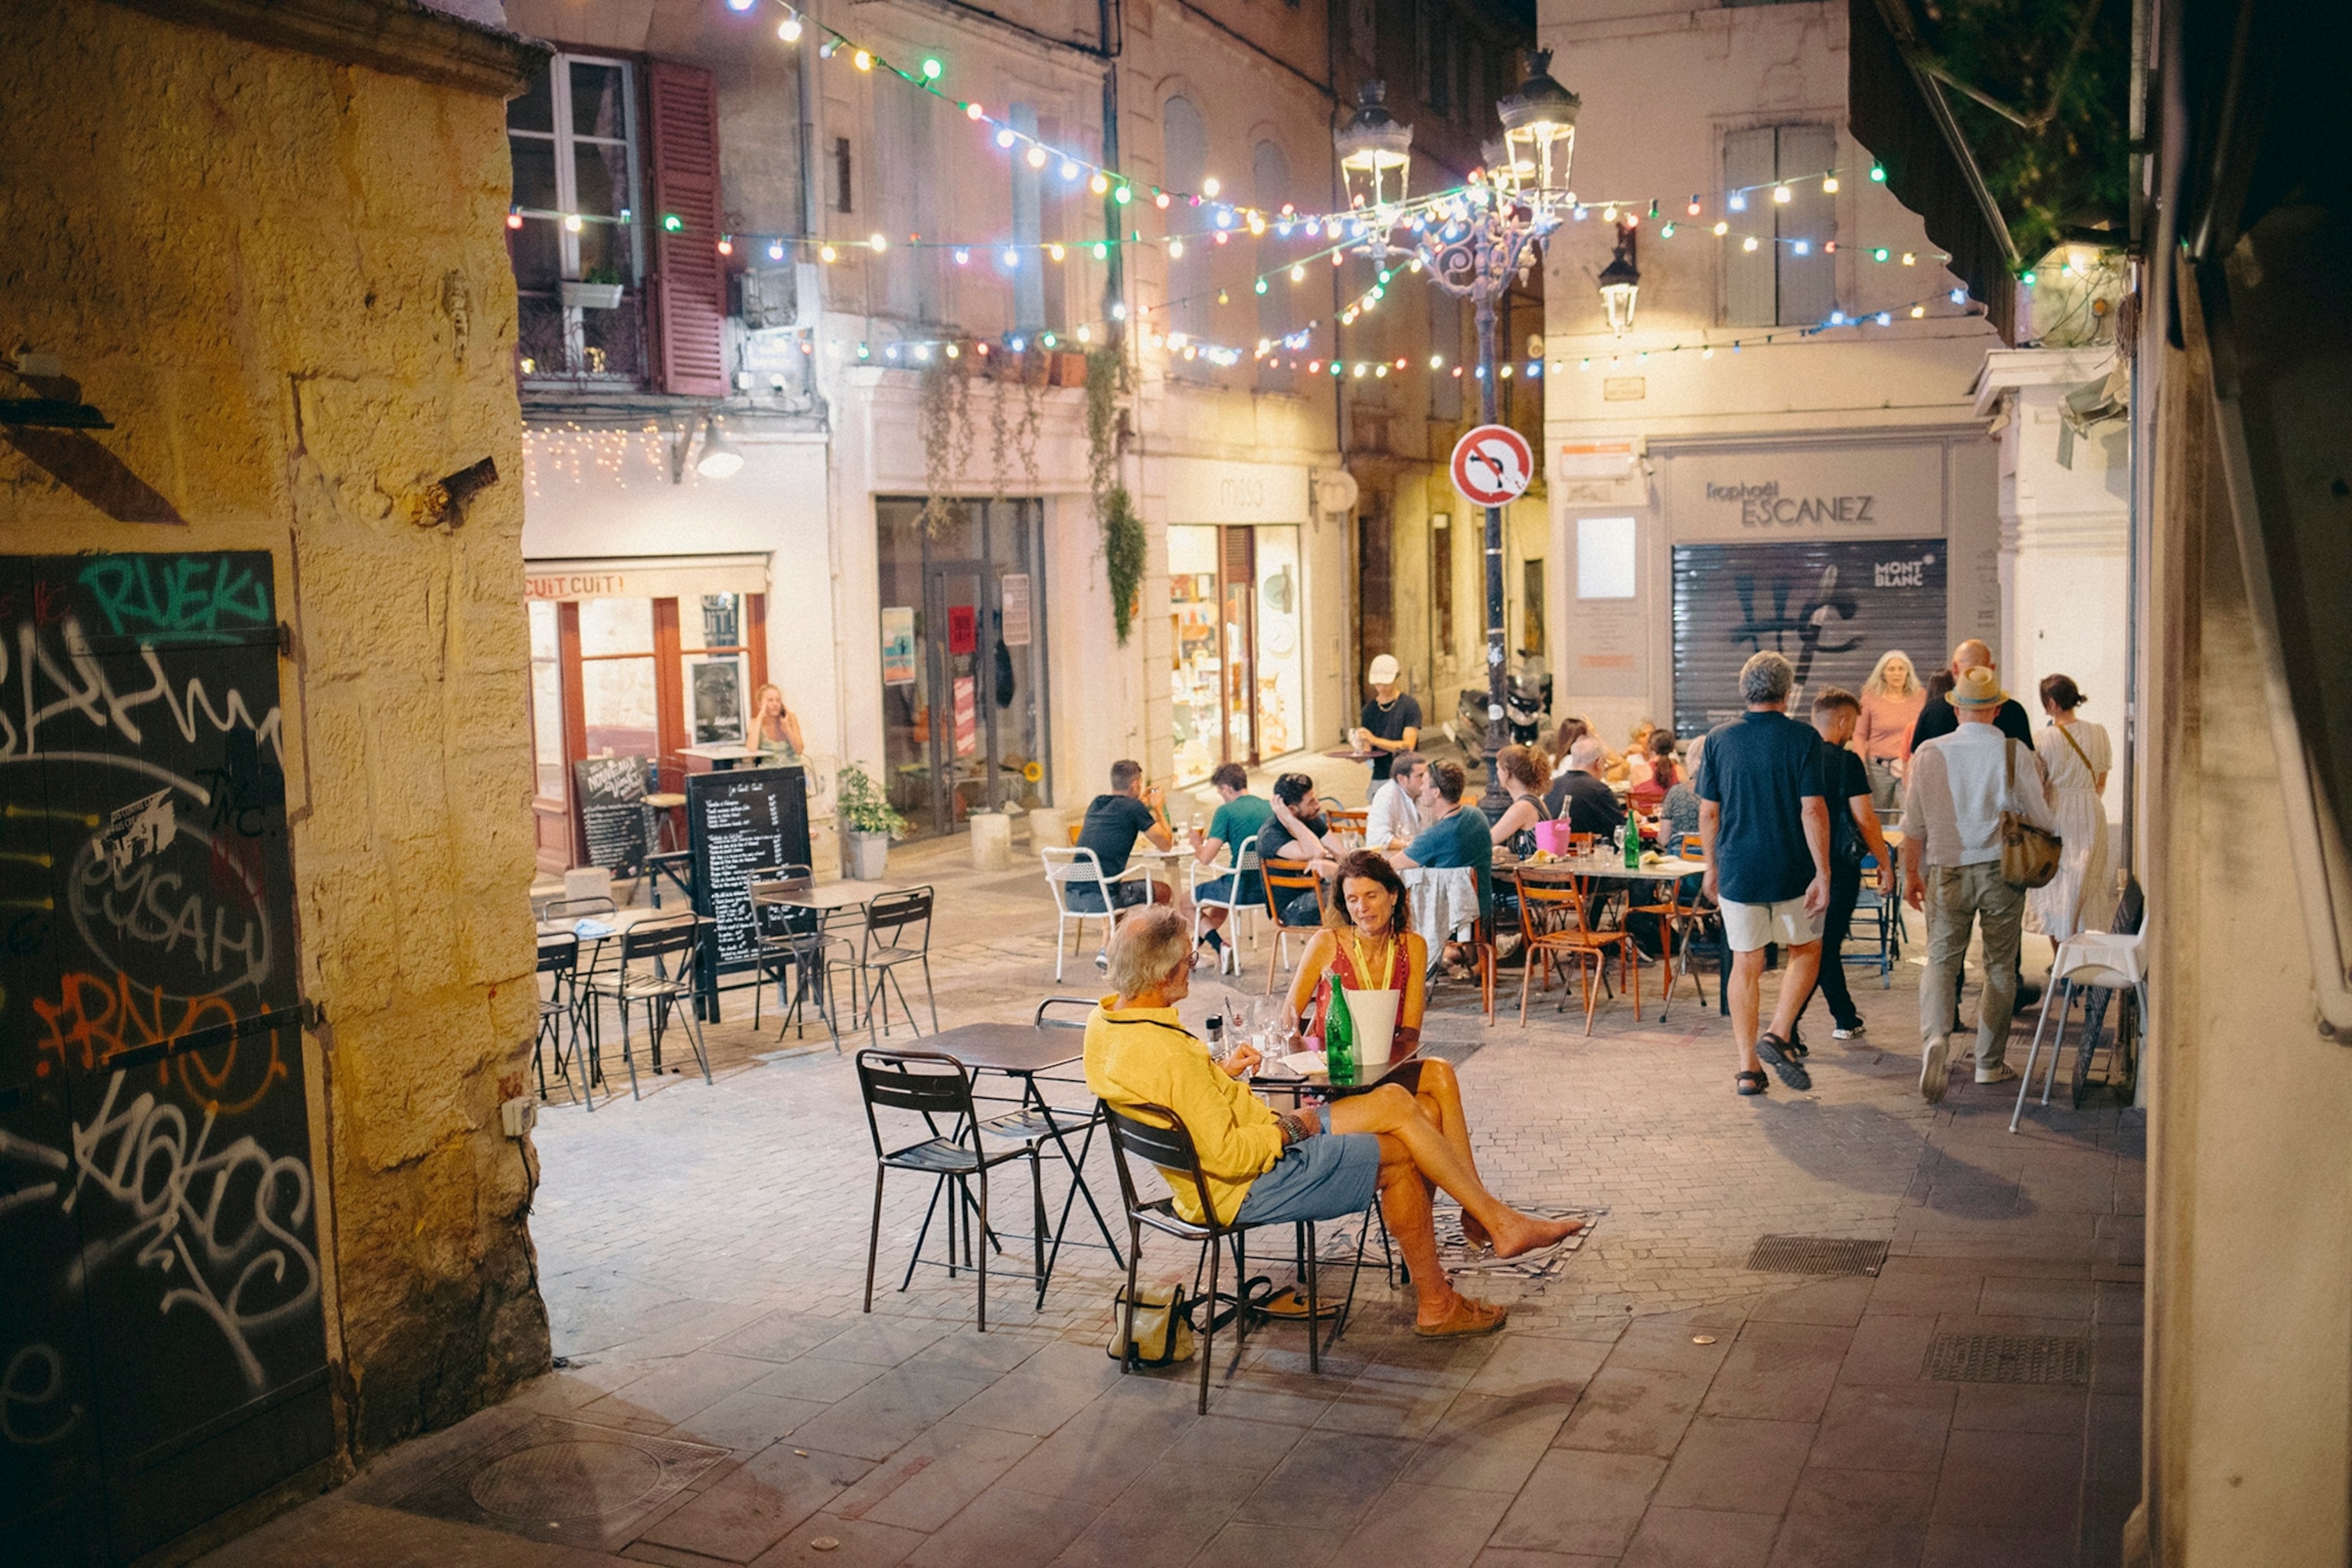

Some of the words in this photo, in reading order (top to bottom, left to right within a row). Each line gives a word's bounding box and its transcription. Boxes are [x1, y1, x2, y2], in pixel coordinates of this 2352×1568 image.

[1707, 481, 1779, 502] Raphaël
[1740, 495, 1873, 525] ESCANEZ
[1875, 561, 1922, 574] MONT
[1875, 573, 1923, 588] BLANC
